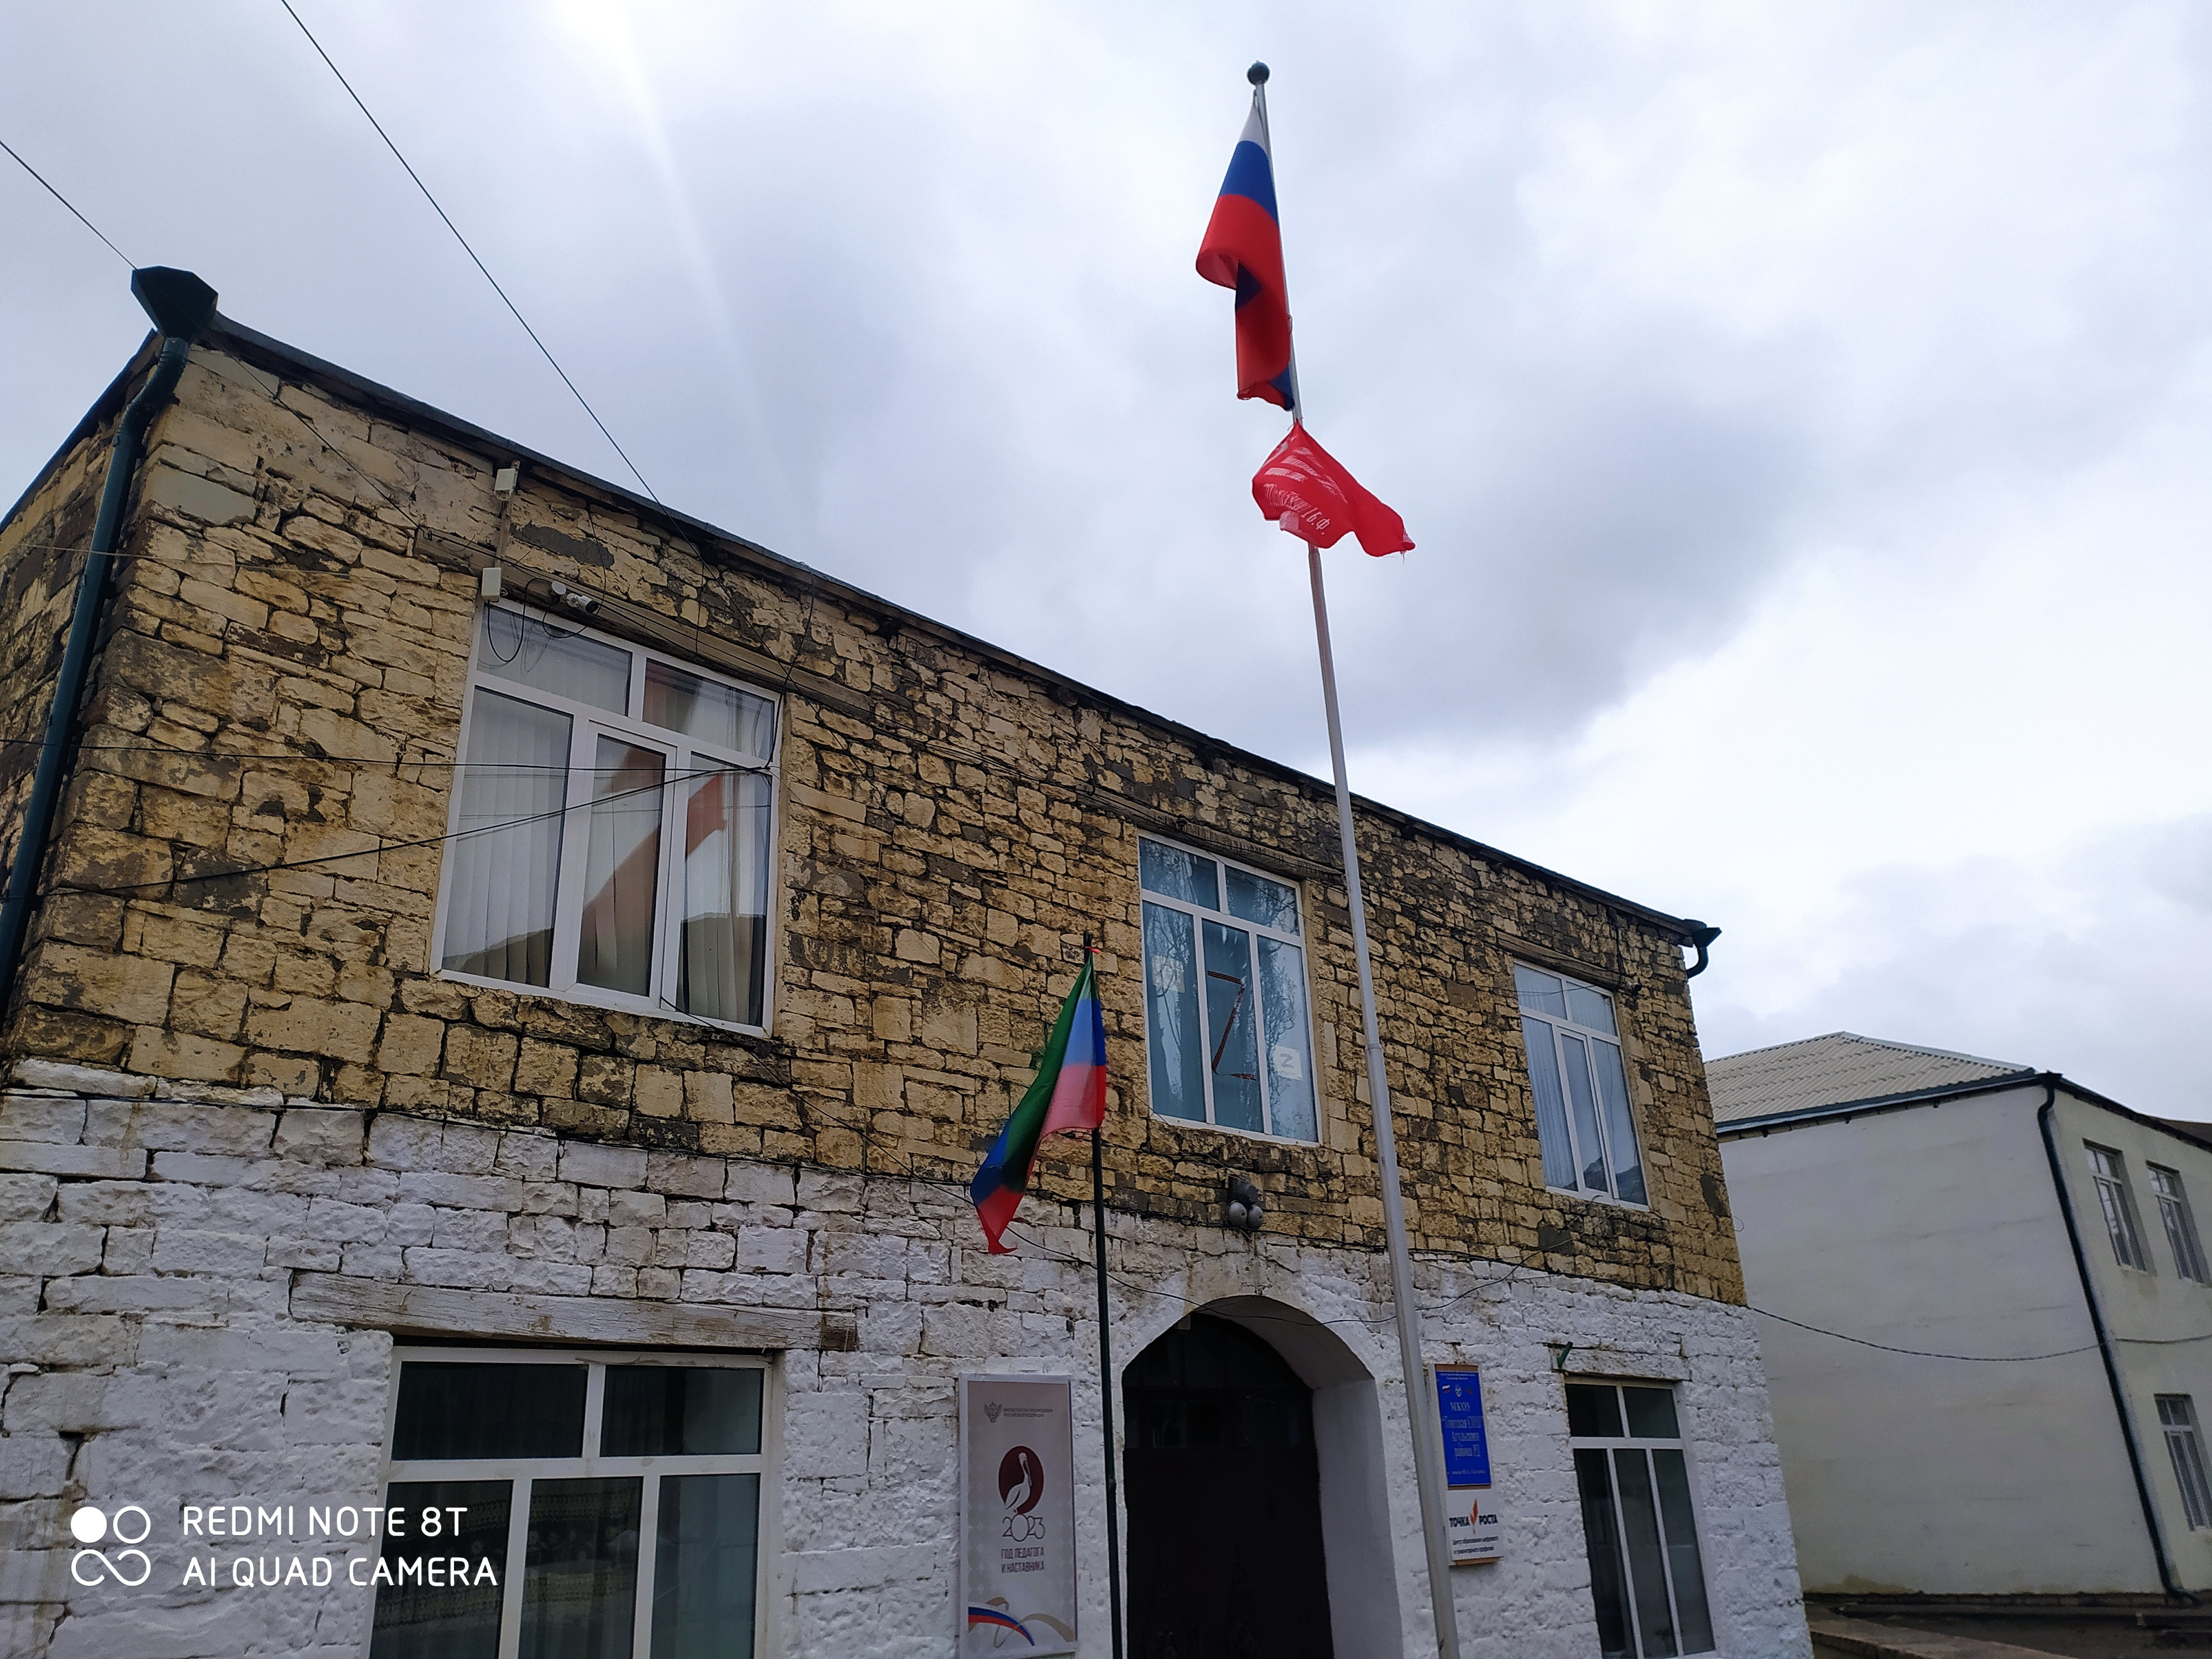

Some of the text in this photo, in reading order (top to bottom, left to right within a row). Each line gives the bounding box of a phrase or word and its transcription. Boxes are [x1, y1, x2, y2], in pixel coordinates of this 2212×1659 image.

[1002, 1513, 1046, 1542] 2023
[1448, 1514, 1499, 1528] ТОЧКА РОСТА
[1001, 1547, 1045, 1559] ГОД ПЕДАГОГА
[1006, 1561, 1045, 1573] НАСТАВНИКА
